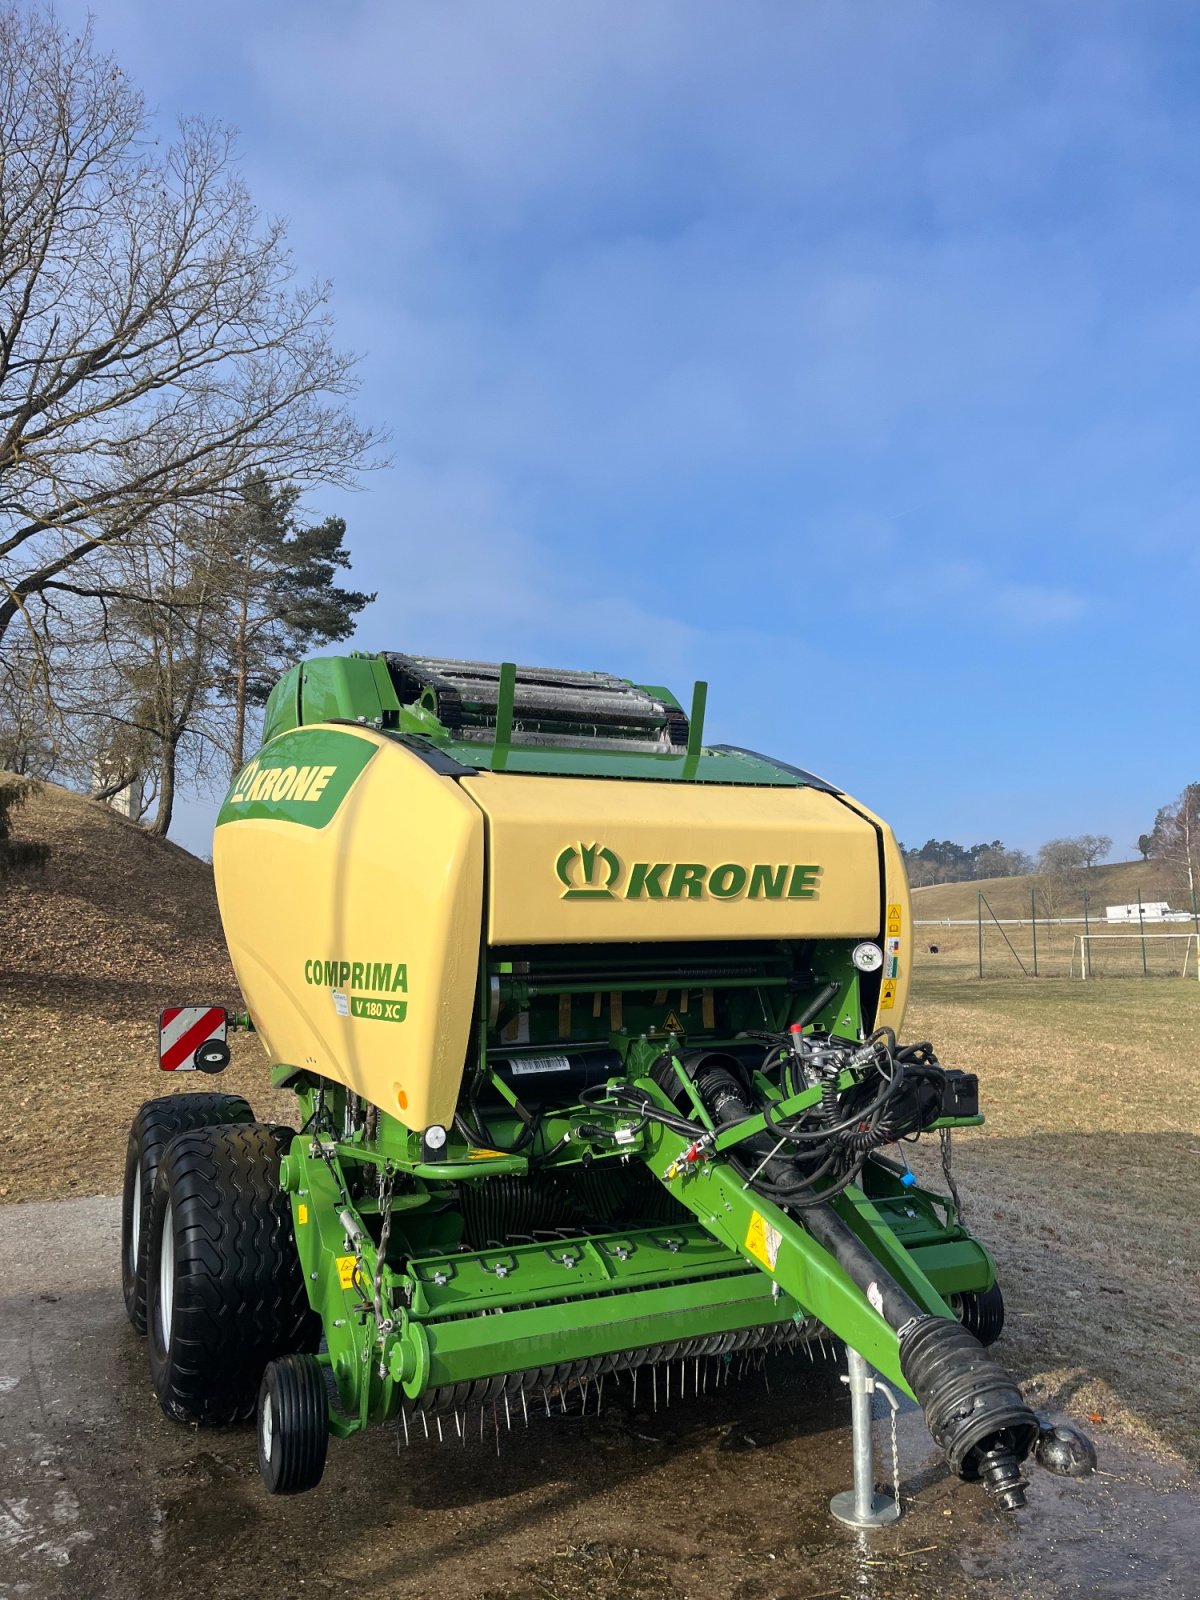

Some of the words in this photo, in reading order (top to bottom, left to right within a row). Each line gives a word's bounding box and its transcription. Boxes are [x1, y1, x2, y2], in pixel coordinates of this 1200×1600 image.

[245, 766, 337, 801] KRONE
[625, 863, 820, 899] KRONE
[305, 959, 408, 993] COMPRIMA
[356, 1001, 363, 1014] V
[365, 1002, 382, 1016] 180
[385, 1004, 401, 1019] XC
